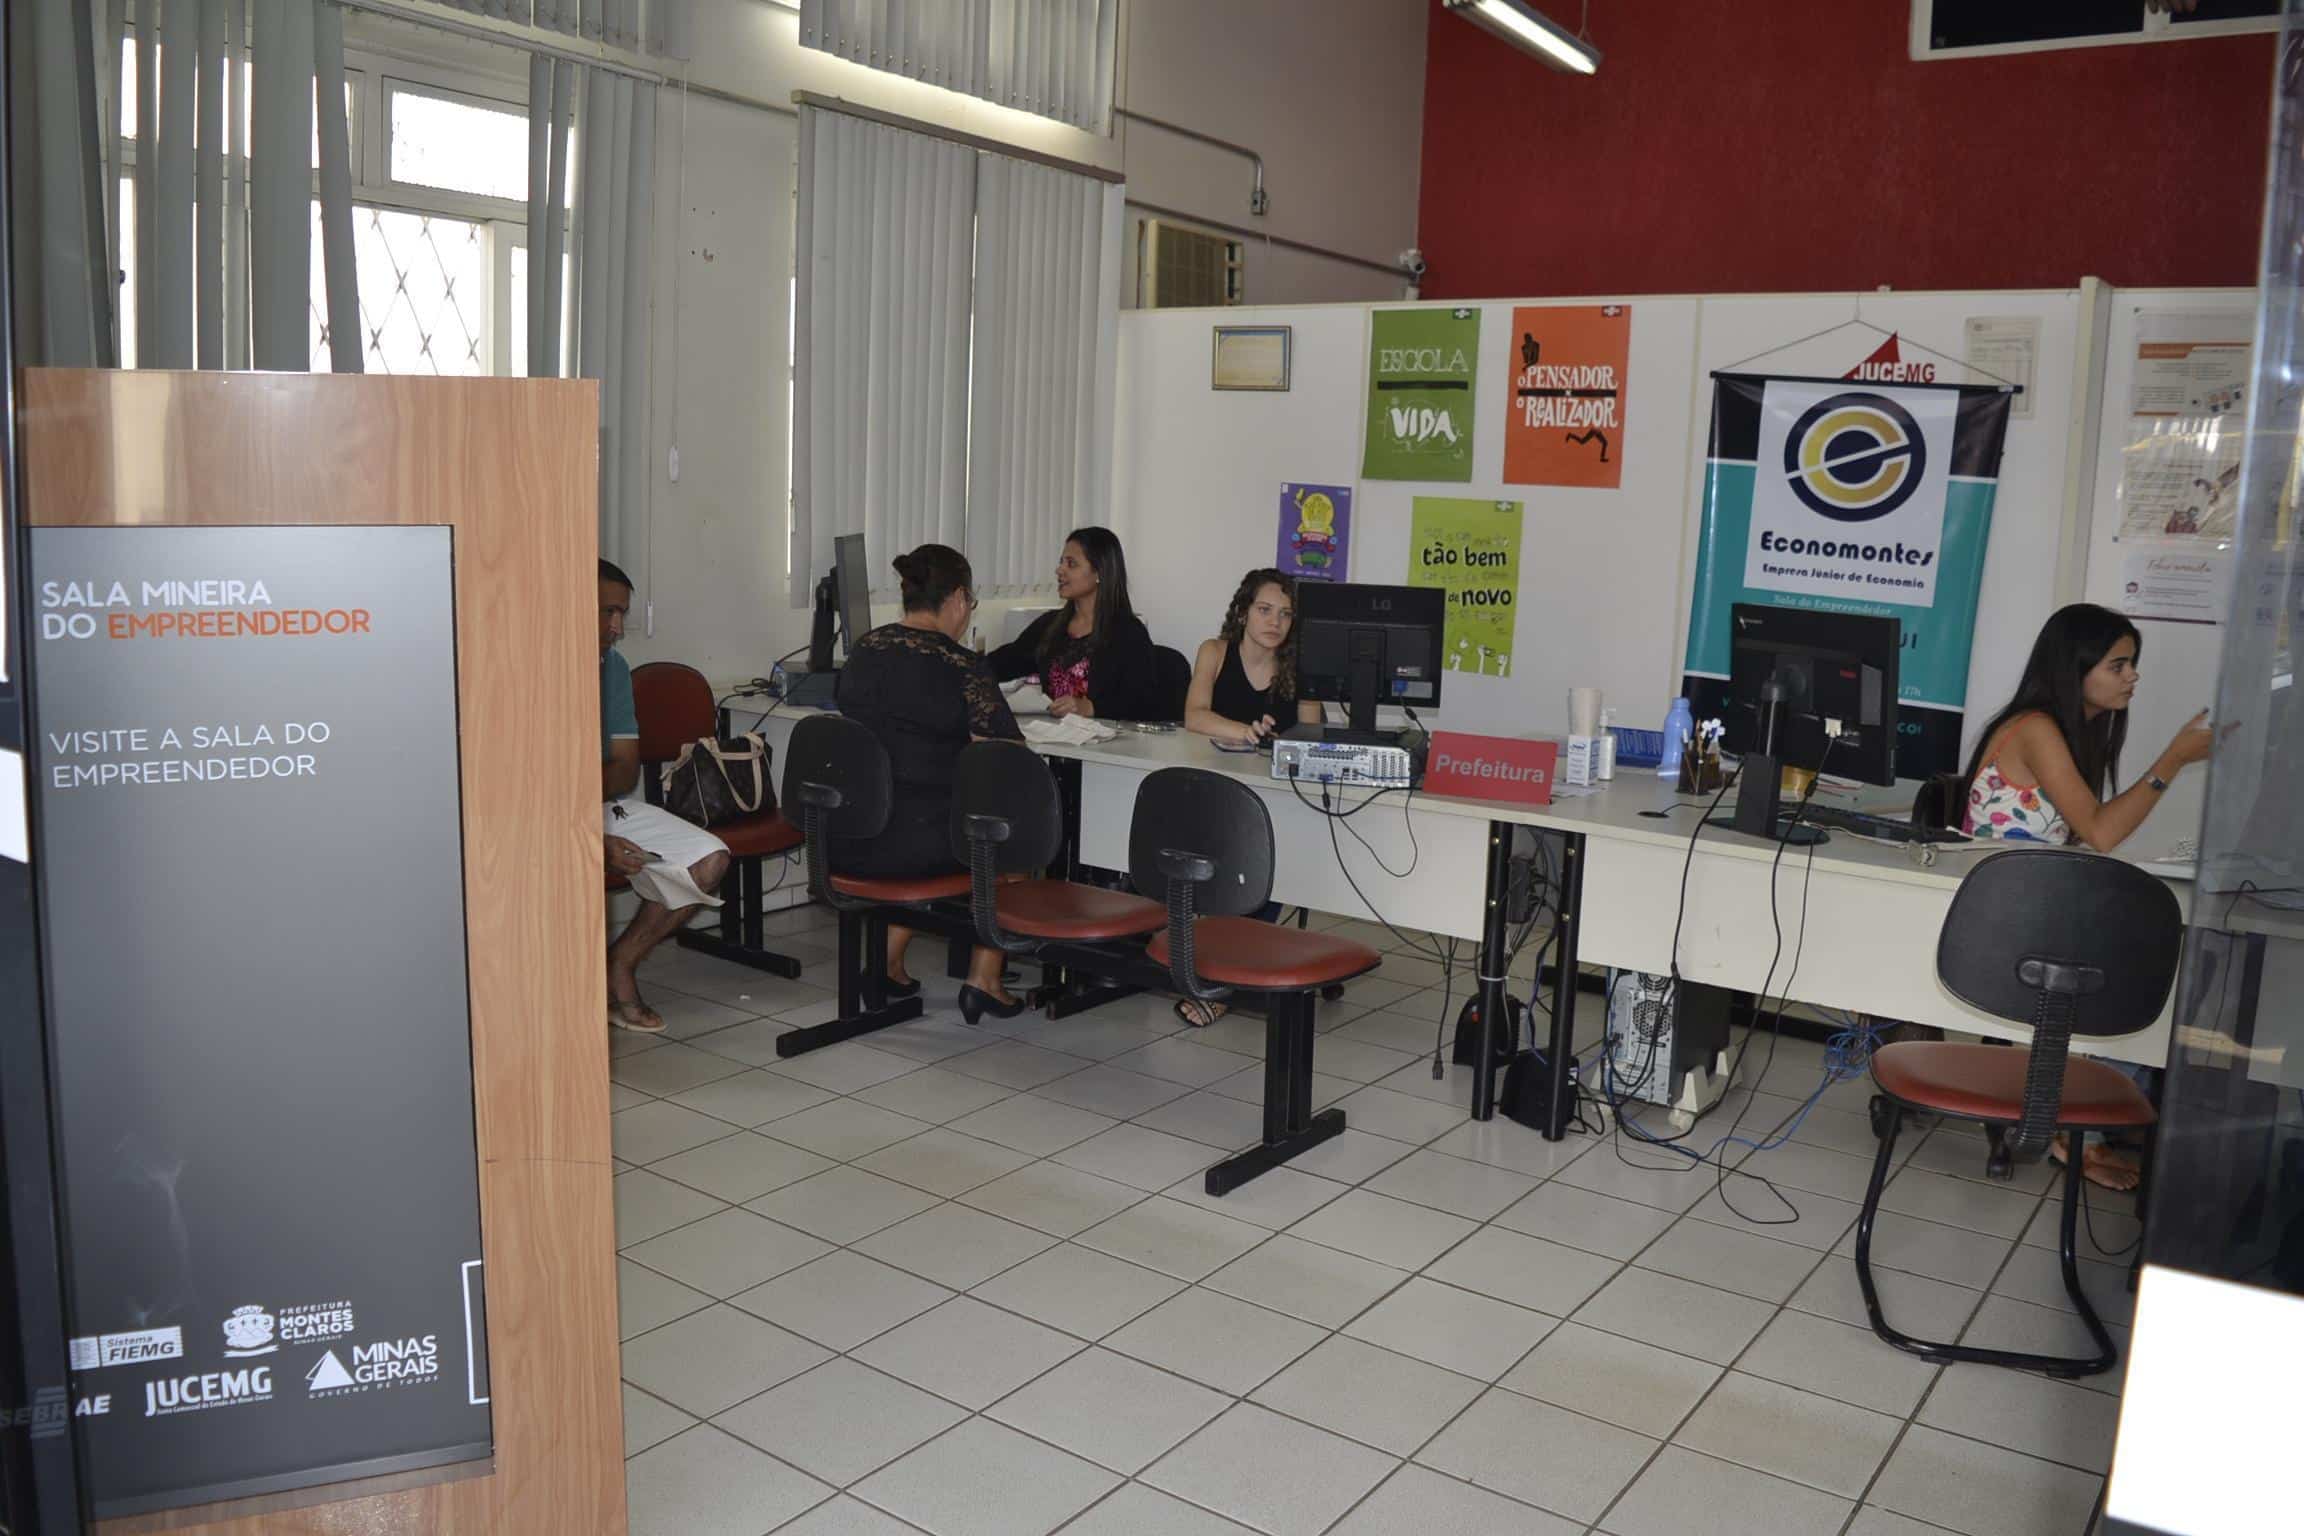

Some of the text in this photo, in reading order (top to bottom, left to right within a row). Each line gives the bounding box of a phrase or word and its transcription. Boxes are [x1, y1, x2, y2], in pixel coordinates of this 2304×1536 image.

[1379, 348, 1469, 373] ESCOLA
[1854, 362, 1935, 383] JUCEMG
[1526, 366, 1618, 389] PENSADOR
[1390, 406, 1458, 443] VIDA
[1423, 541, 1507, 566] tão bem
[1760, 530, 1934, 567] Economontes
[1762, 563, 1808, 578] Empresa
[1848, 572, 1863, 583] de
[1866, 574, 1925, 589] Economia
[42, 580, 272, 608] SALA MINEIRA
[1448, 589, 1512, 607] de novo
[42, 608, 371, 640] DO EMPREENDEDOR
[49, 721, 331, 755] VISITE A SALA DO
[53, 755, 316, 788] EMPREENDEDOR
[1434, 754, 1545, 784] Prefeitura
[279, 1309, 353, 1329] MONTES
[280, 1300, 352, 1316] PREFEITURA
[107, 1337, 153, 1346] Sistema
[280, 1320, 354, 1340] CLAROS
[110, 1341, 174, 1361] FIEMG
[352, 1335, 437, 1365] MINAS
[354, 1355, 438, 1383] GERAIS
[144, 1366, 272, 1417] JUCEMG
[309, 1384, 369, 1400] GOVERNO
